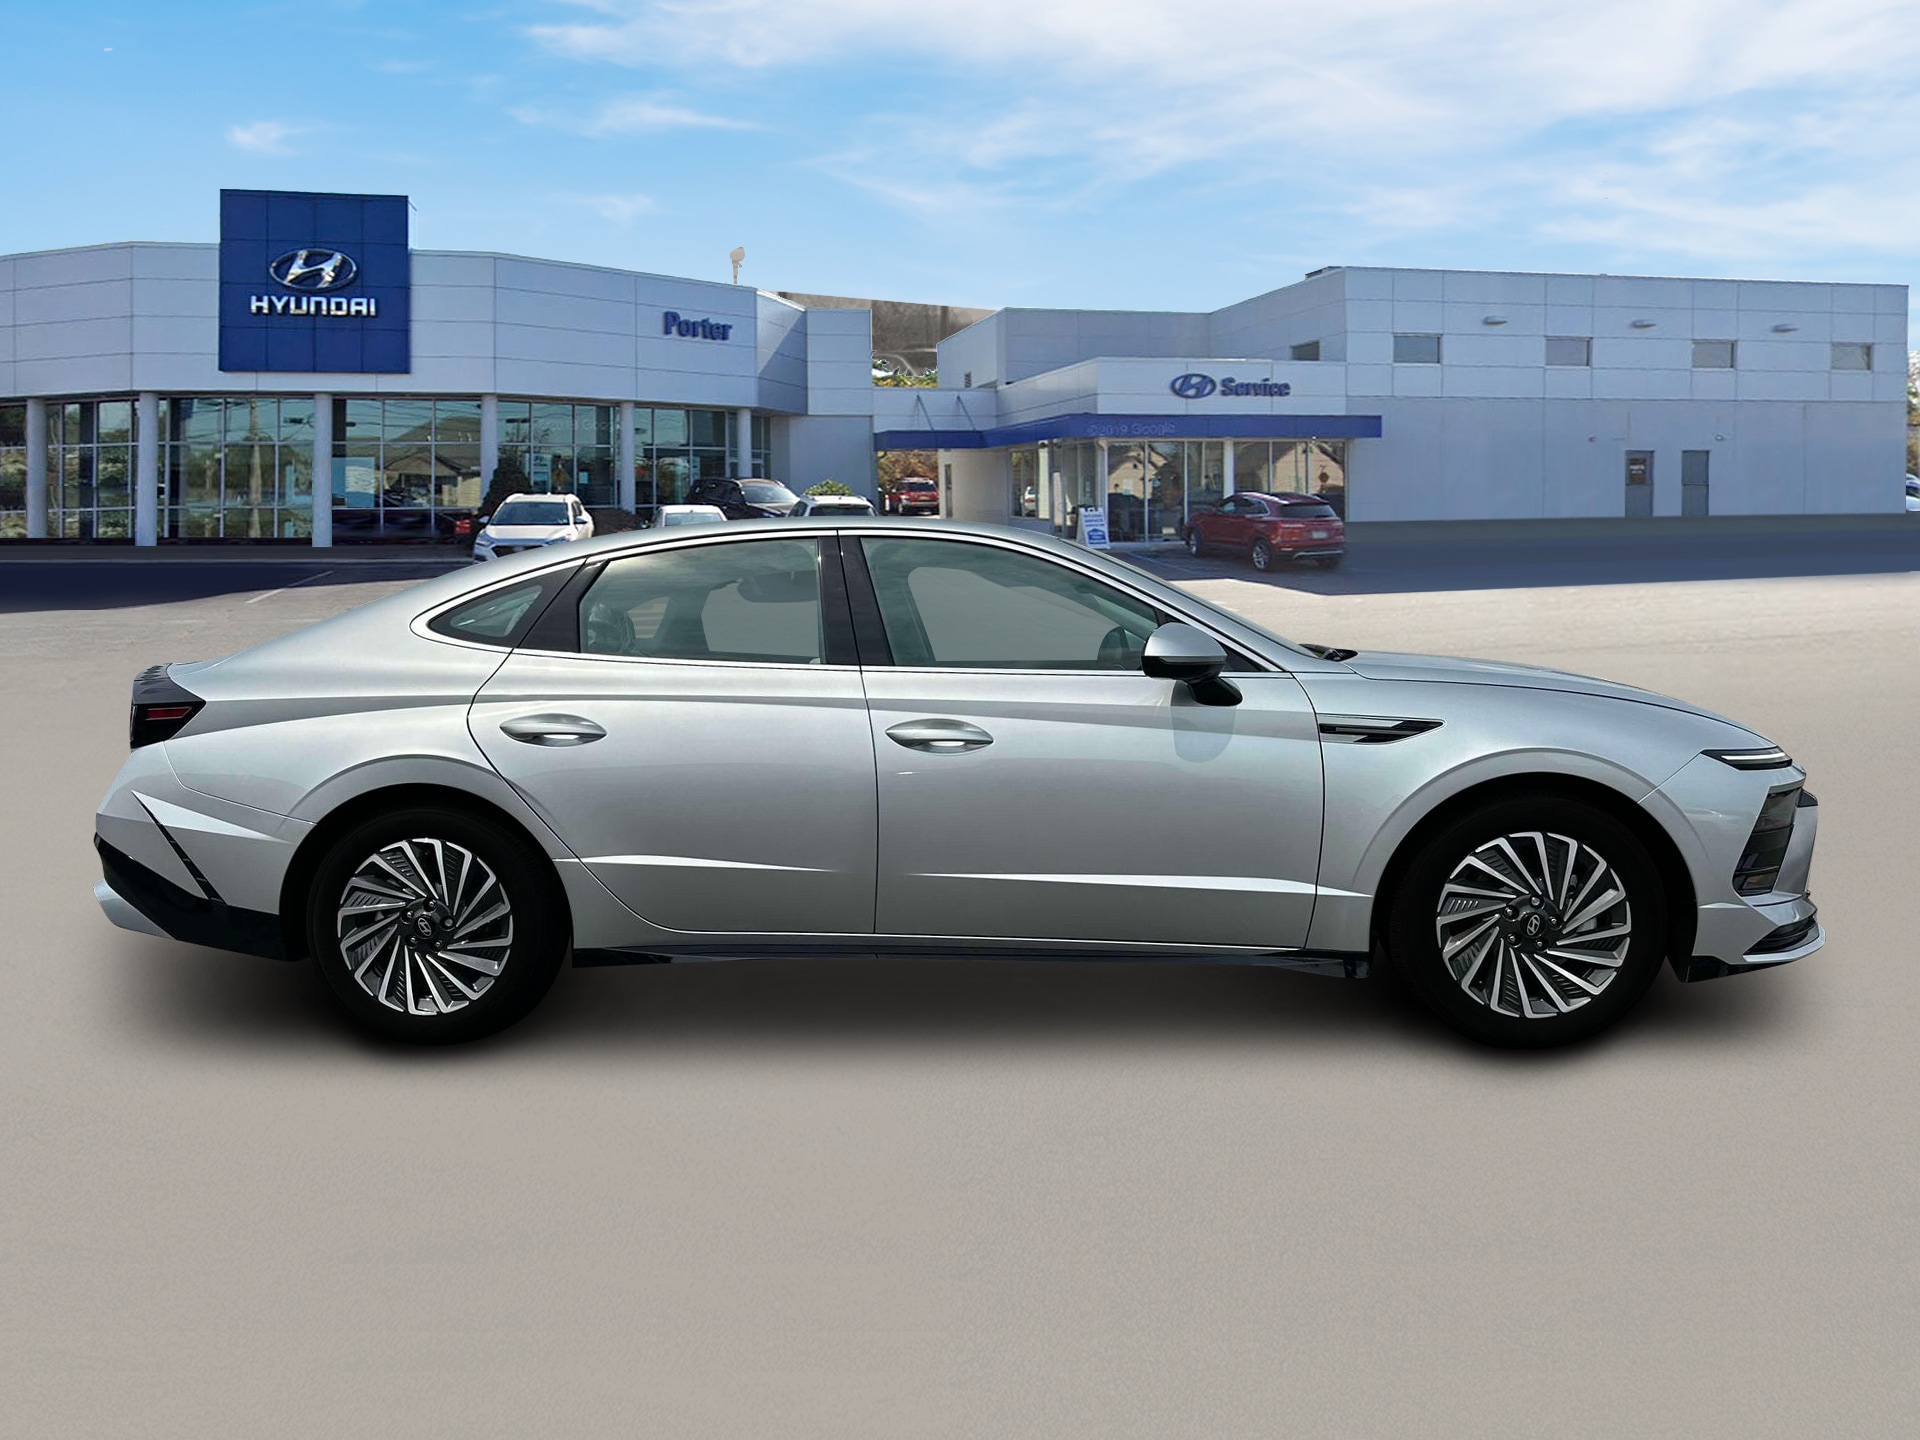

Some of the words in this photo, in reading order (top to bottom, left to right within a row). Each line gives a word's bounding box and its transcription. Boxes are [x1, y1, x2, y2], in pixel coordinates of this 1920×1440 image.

[250, 295, 377, 317] HYUNDAI
[663, 311, 733, 341] Porter
[1220, 377, 1291, 397] Service
